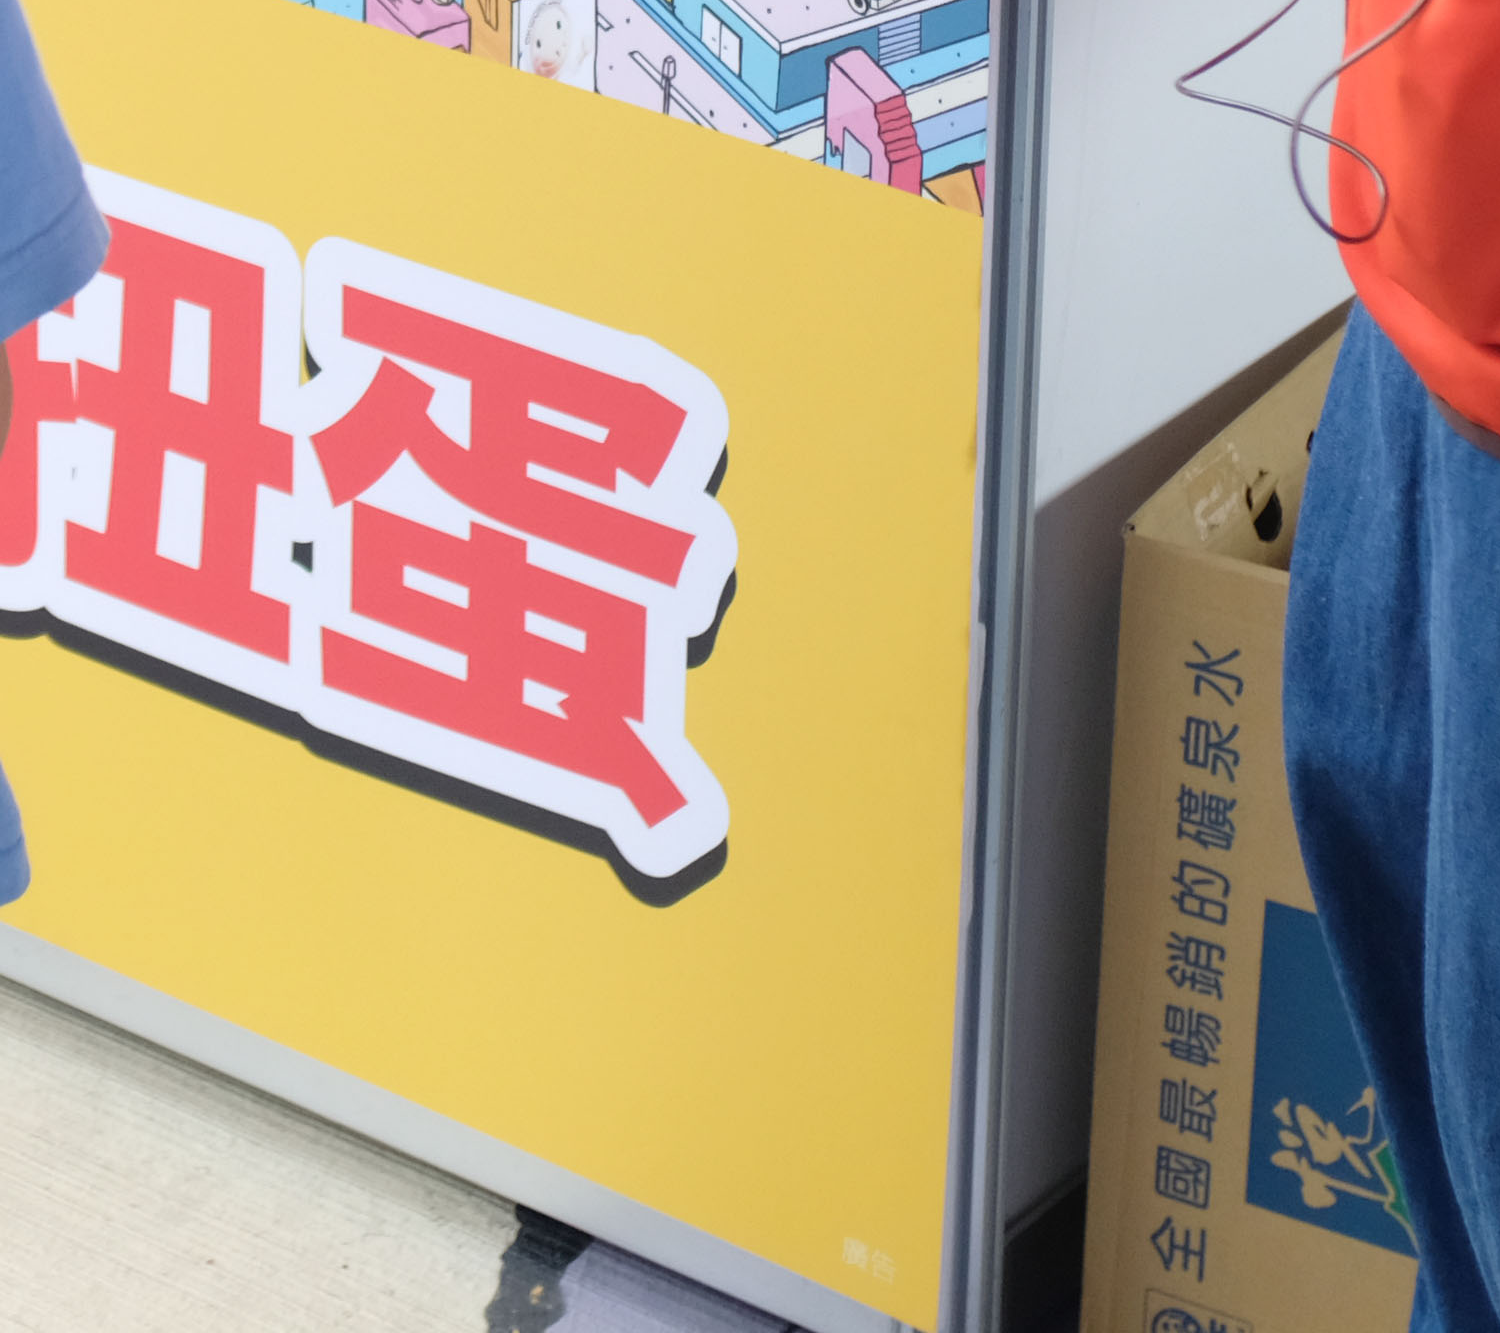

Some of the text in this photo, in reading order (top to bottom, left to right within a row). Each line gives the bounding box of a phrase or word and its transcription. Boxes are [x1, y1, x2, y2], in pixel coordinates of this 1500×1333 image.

[1149, 638, 1245, 1283] 全國最暢銷的礦泉水
